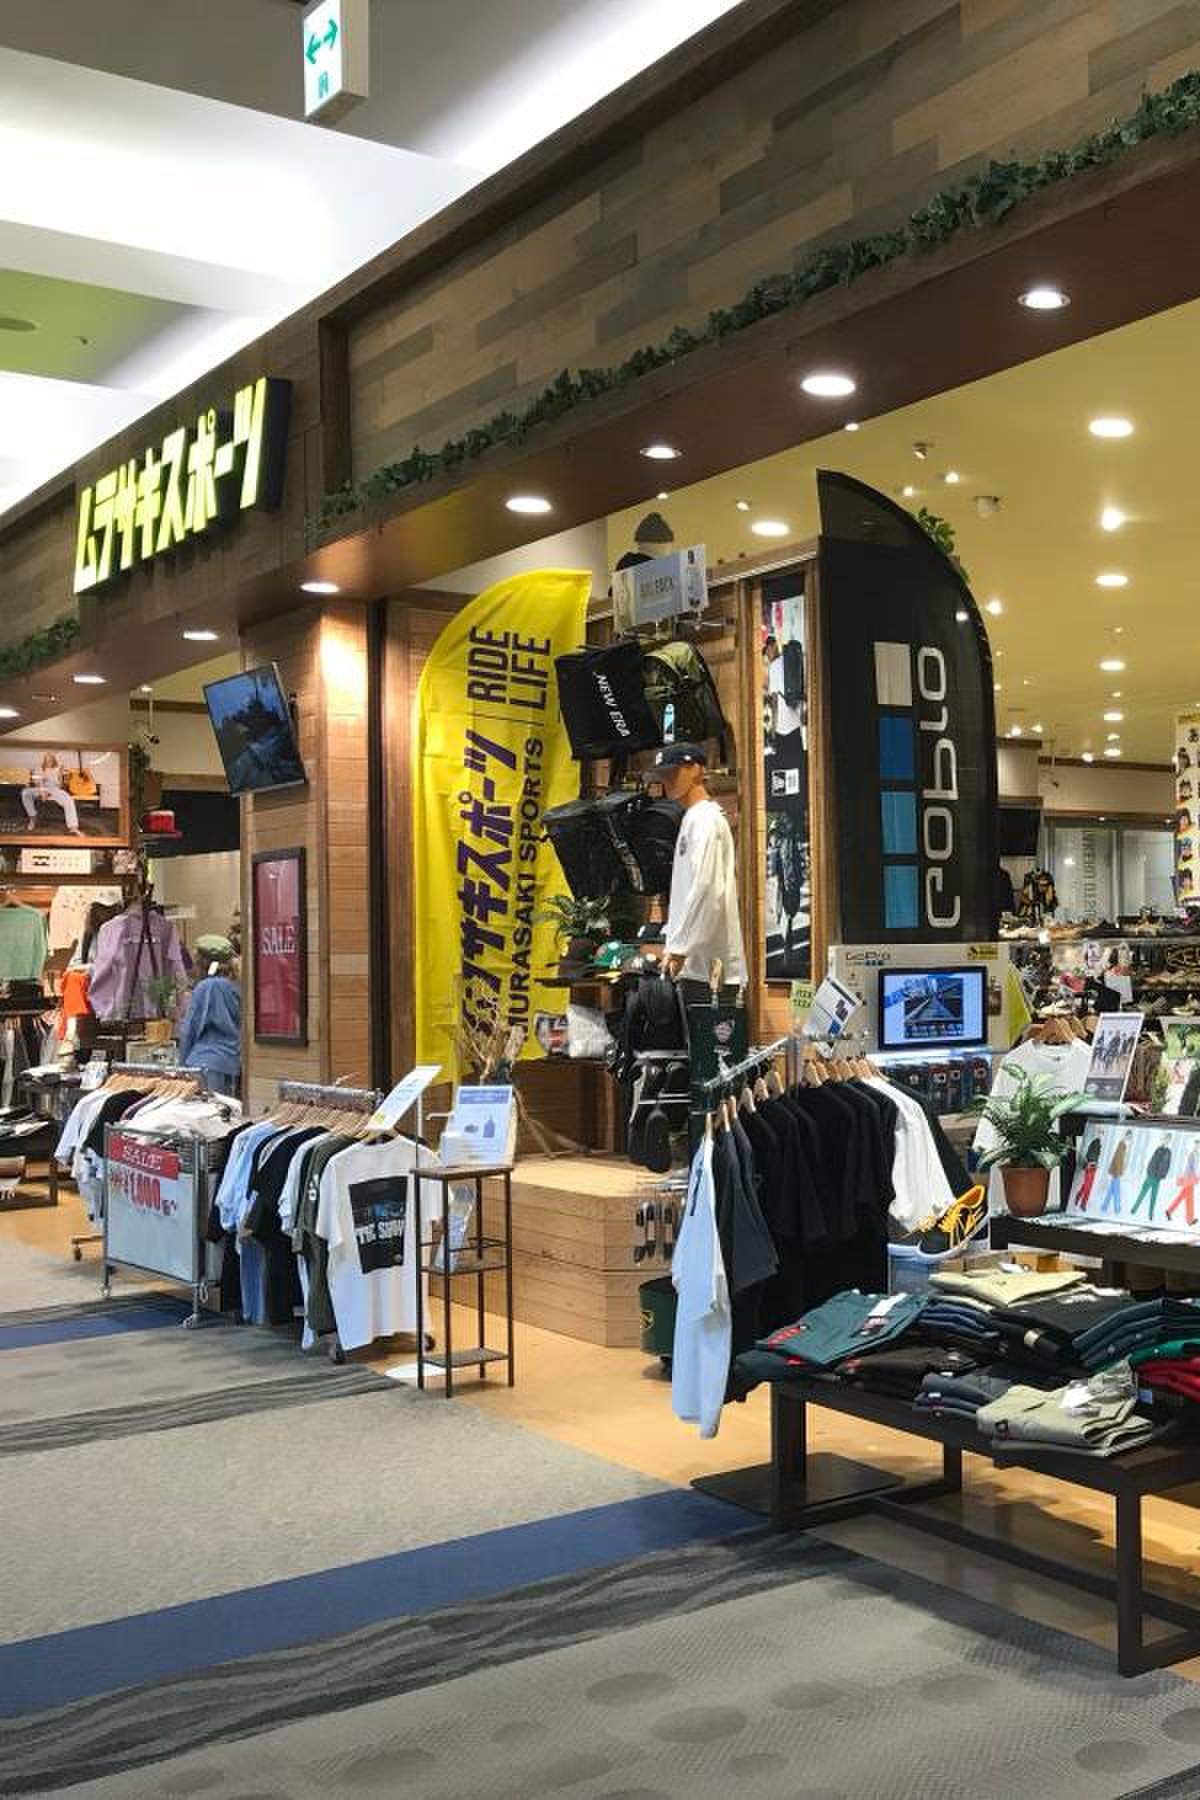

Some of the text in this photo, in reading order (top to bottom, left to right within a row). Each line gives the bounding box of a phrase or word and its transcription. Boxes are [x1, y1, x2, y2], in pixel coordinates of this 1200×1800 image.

[74, 376, 267, 594] ムラサキスポーツ
[467, 626, 509, 703] RIDE
[509, 637, 551, 714] LIFE
[592, 671, 631, 737] NEW ERA
[519, 735, 544, 862] SPORTS
[261, 925, 295, 954] SALE
